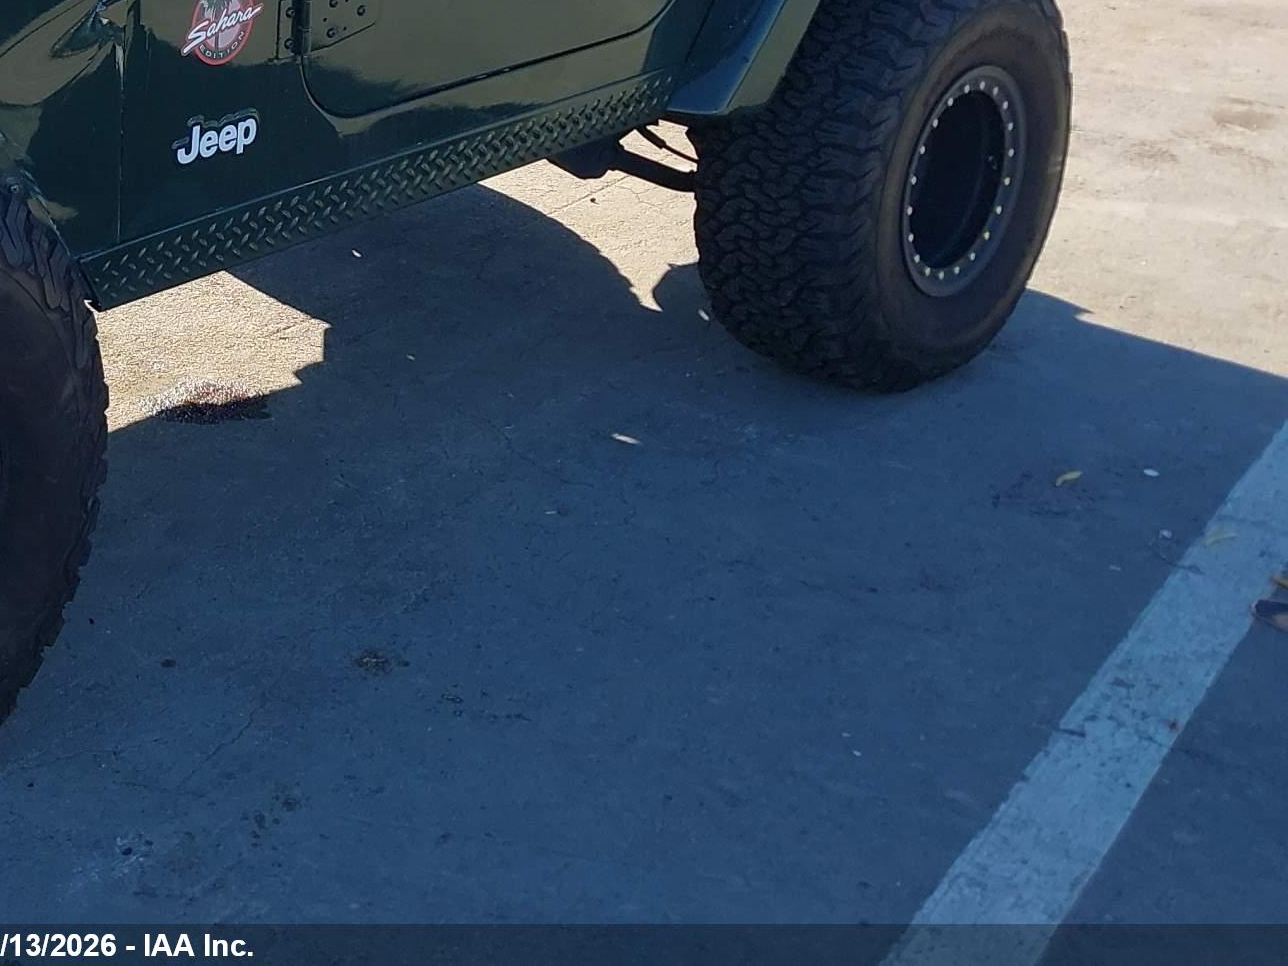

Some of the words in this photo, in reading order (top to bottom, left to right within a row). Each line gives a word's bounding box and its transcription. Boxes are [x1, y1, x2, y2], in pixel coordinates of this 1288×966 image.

[181, 3, 263, 55] Sahara
[199, 31, 245, 59] EDITION
[176, 118, 258, 165] Jeep
